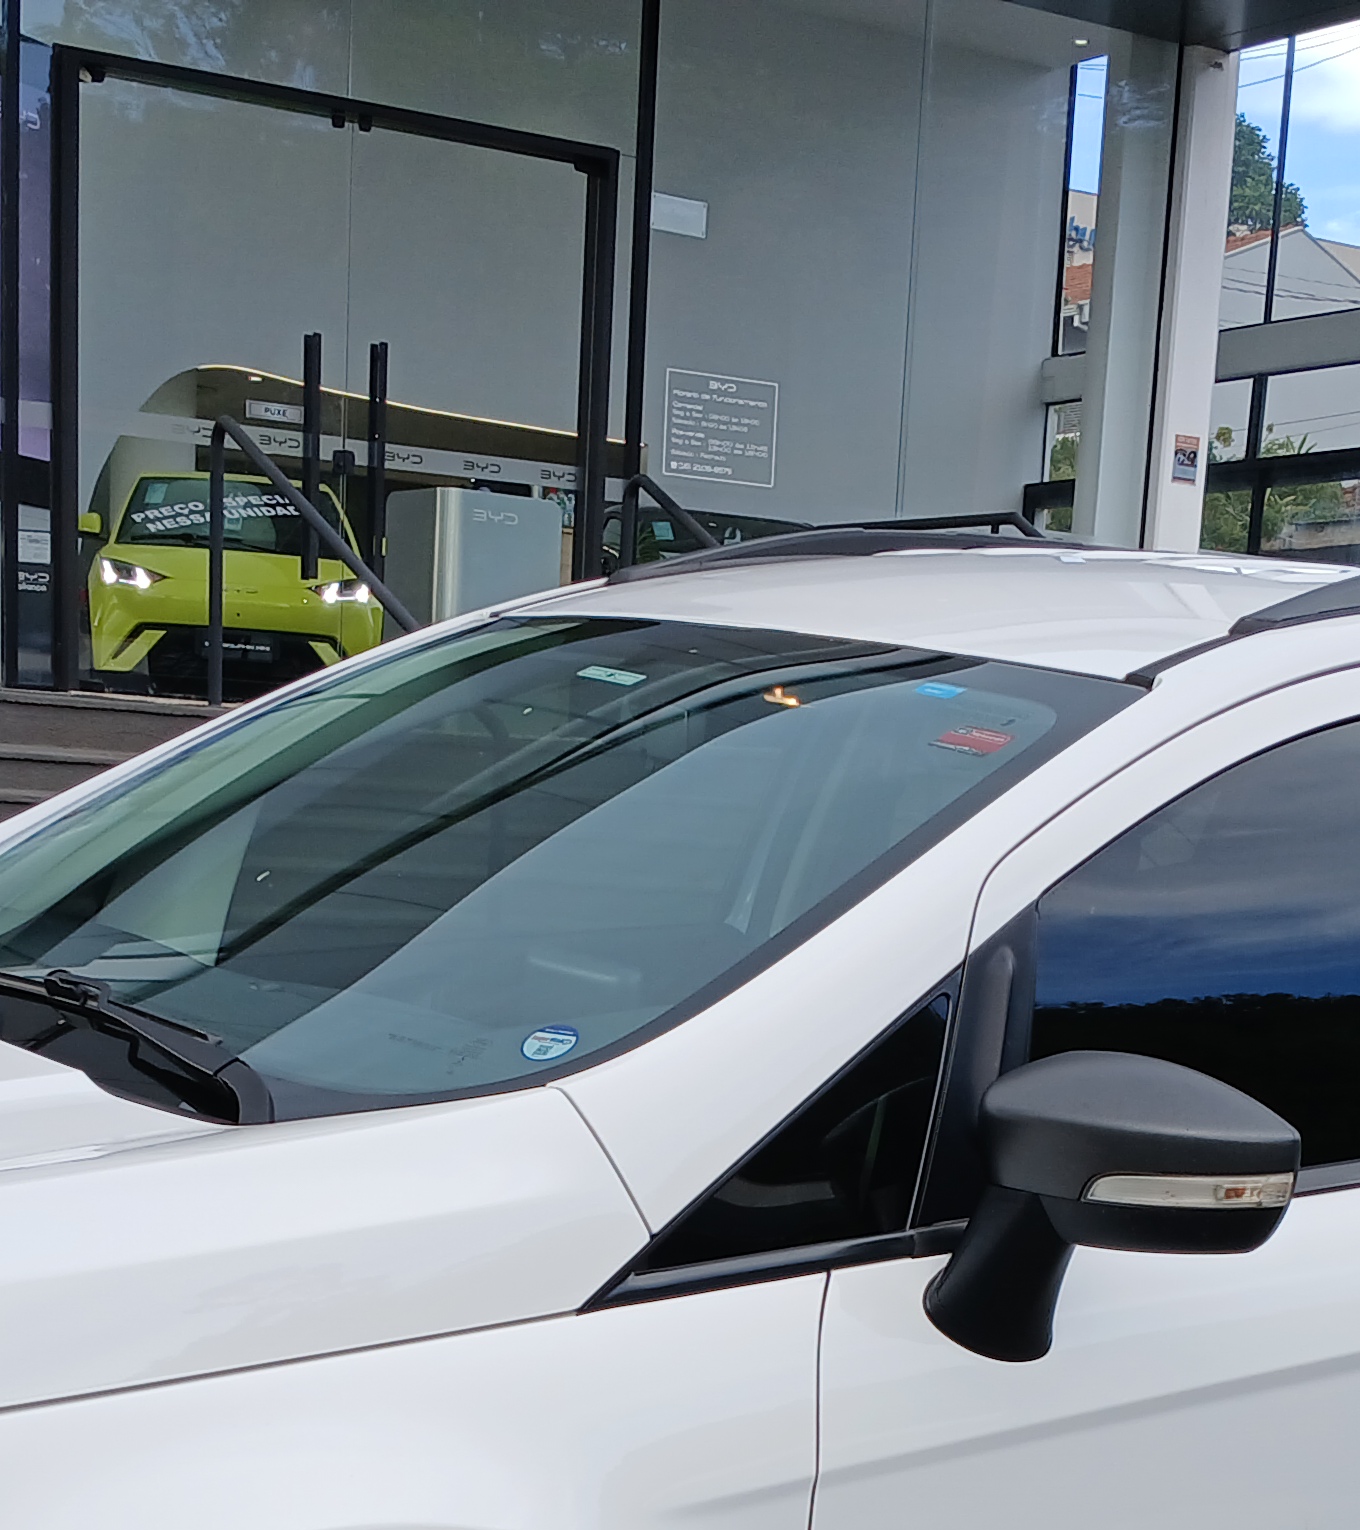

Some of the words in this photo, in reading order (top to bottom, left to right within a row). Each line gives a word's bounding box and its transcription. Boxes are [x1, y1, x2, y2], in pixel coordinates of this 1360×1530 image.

[708, 380, 737, 392] BYD
[264, 407, 289, 418] PUXE
[259, 434, 301, 449] BYD
[384, 451, 423, 465] BYD
[463, 460, 502, 474] BYD
[540, 469, 577, 483] BYD
[131, 501, 205, 523] PREÇO
[472, 508, 518, 525] BYD
